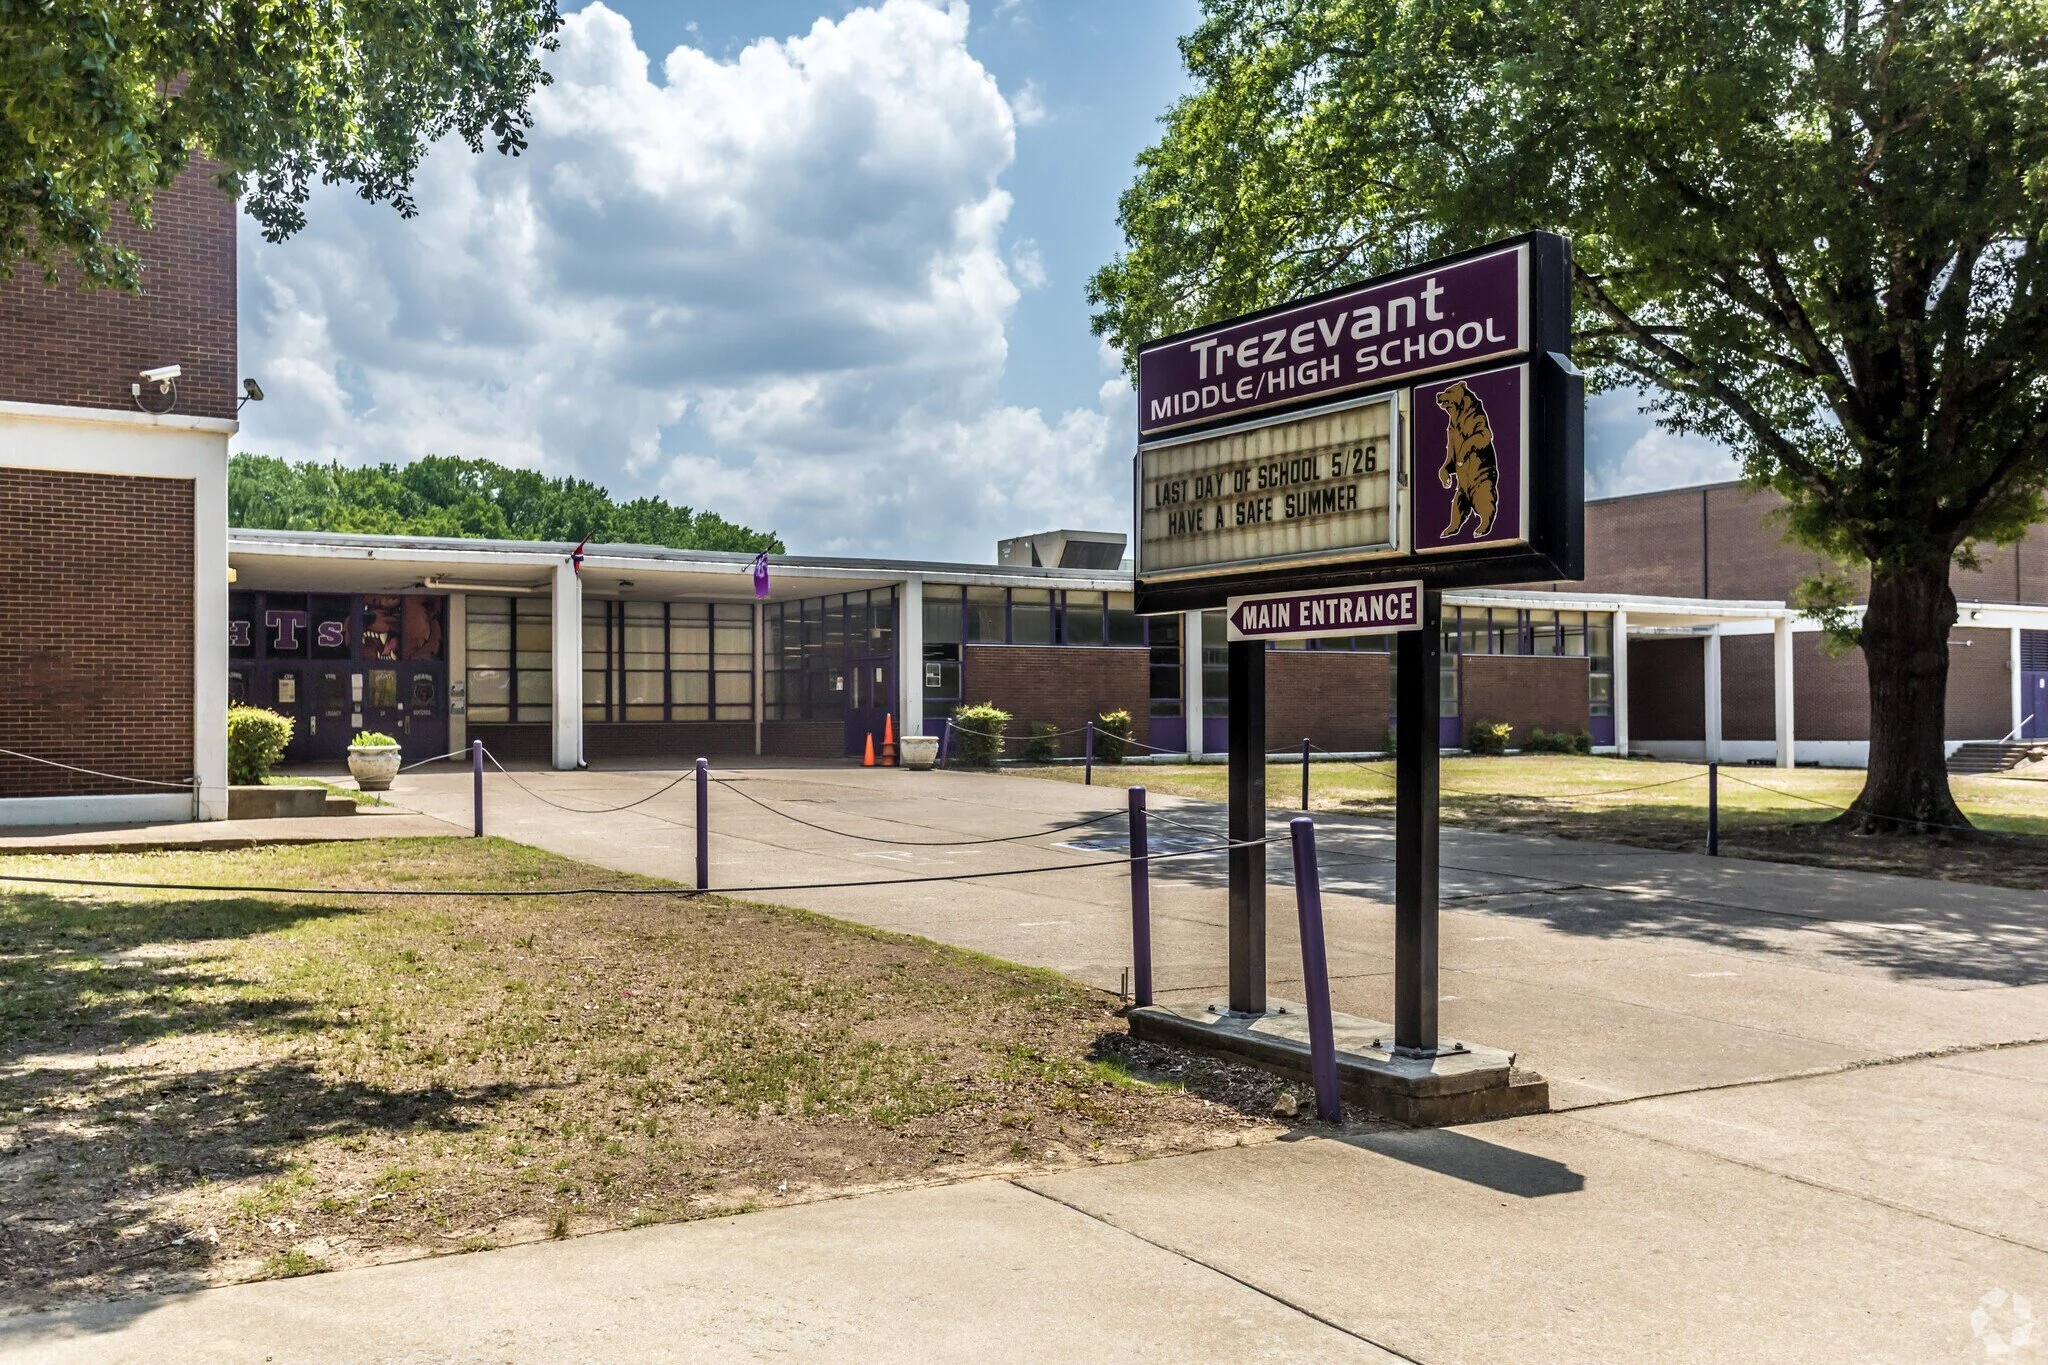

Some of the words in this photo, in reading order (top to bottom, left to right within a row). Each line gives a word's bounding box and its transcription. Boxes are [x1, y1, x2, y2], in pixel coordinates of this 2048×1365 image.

[1151, 354, 1340, 421] MIDDLE/HIGH
[1355, 317, 1506, 373] SCHOOL
[1155, 480, 1187, 506] LAST
[1195, 473, 1223, 500] DAY
[1234, 469, 1251, 493] OF
[1258, 457, 1320, 489] SCHOOL
[1331, 446, 1376, 478] 5/26
[1168, 508, 1203, 536] HAVE
[1215, 505, 1224, 529] A
[1236, 498, 1272, 525] SAFE
[1285, 484, 1357, 518] SUMMER
[1242, 602, 1290, 630] MAIN
[1299, 592, 1413, 626] ENTRANCE
